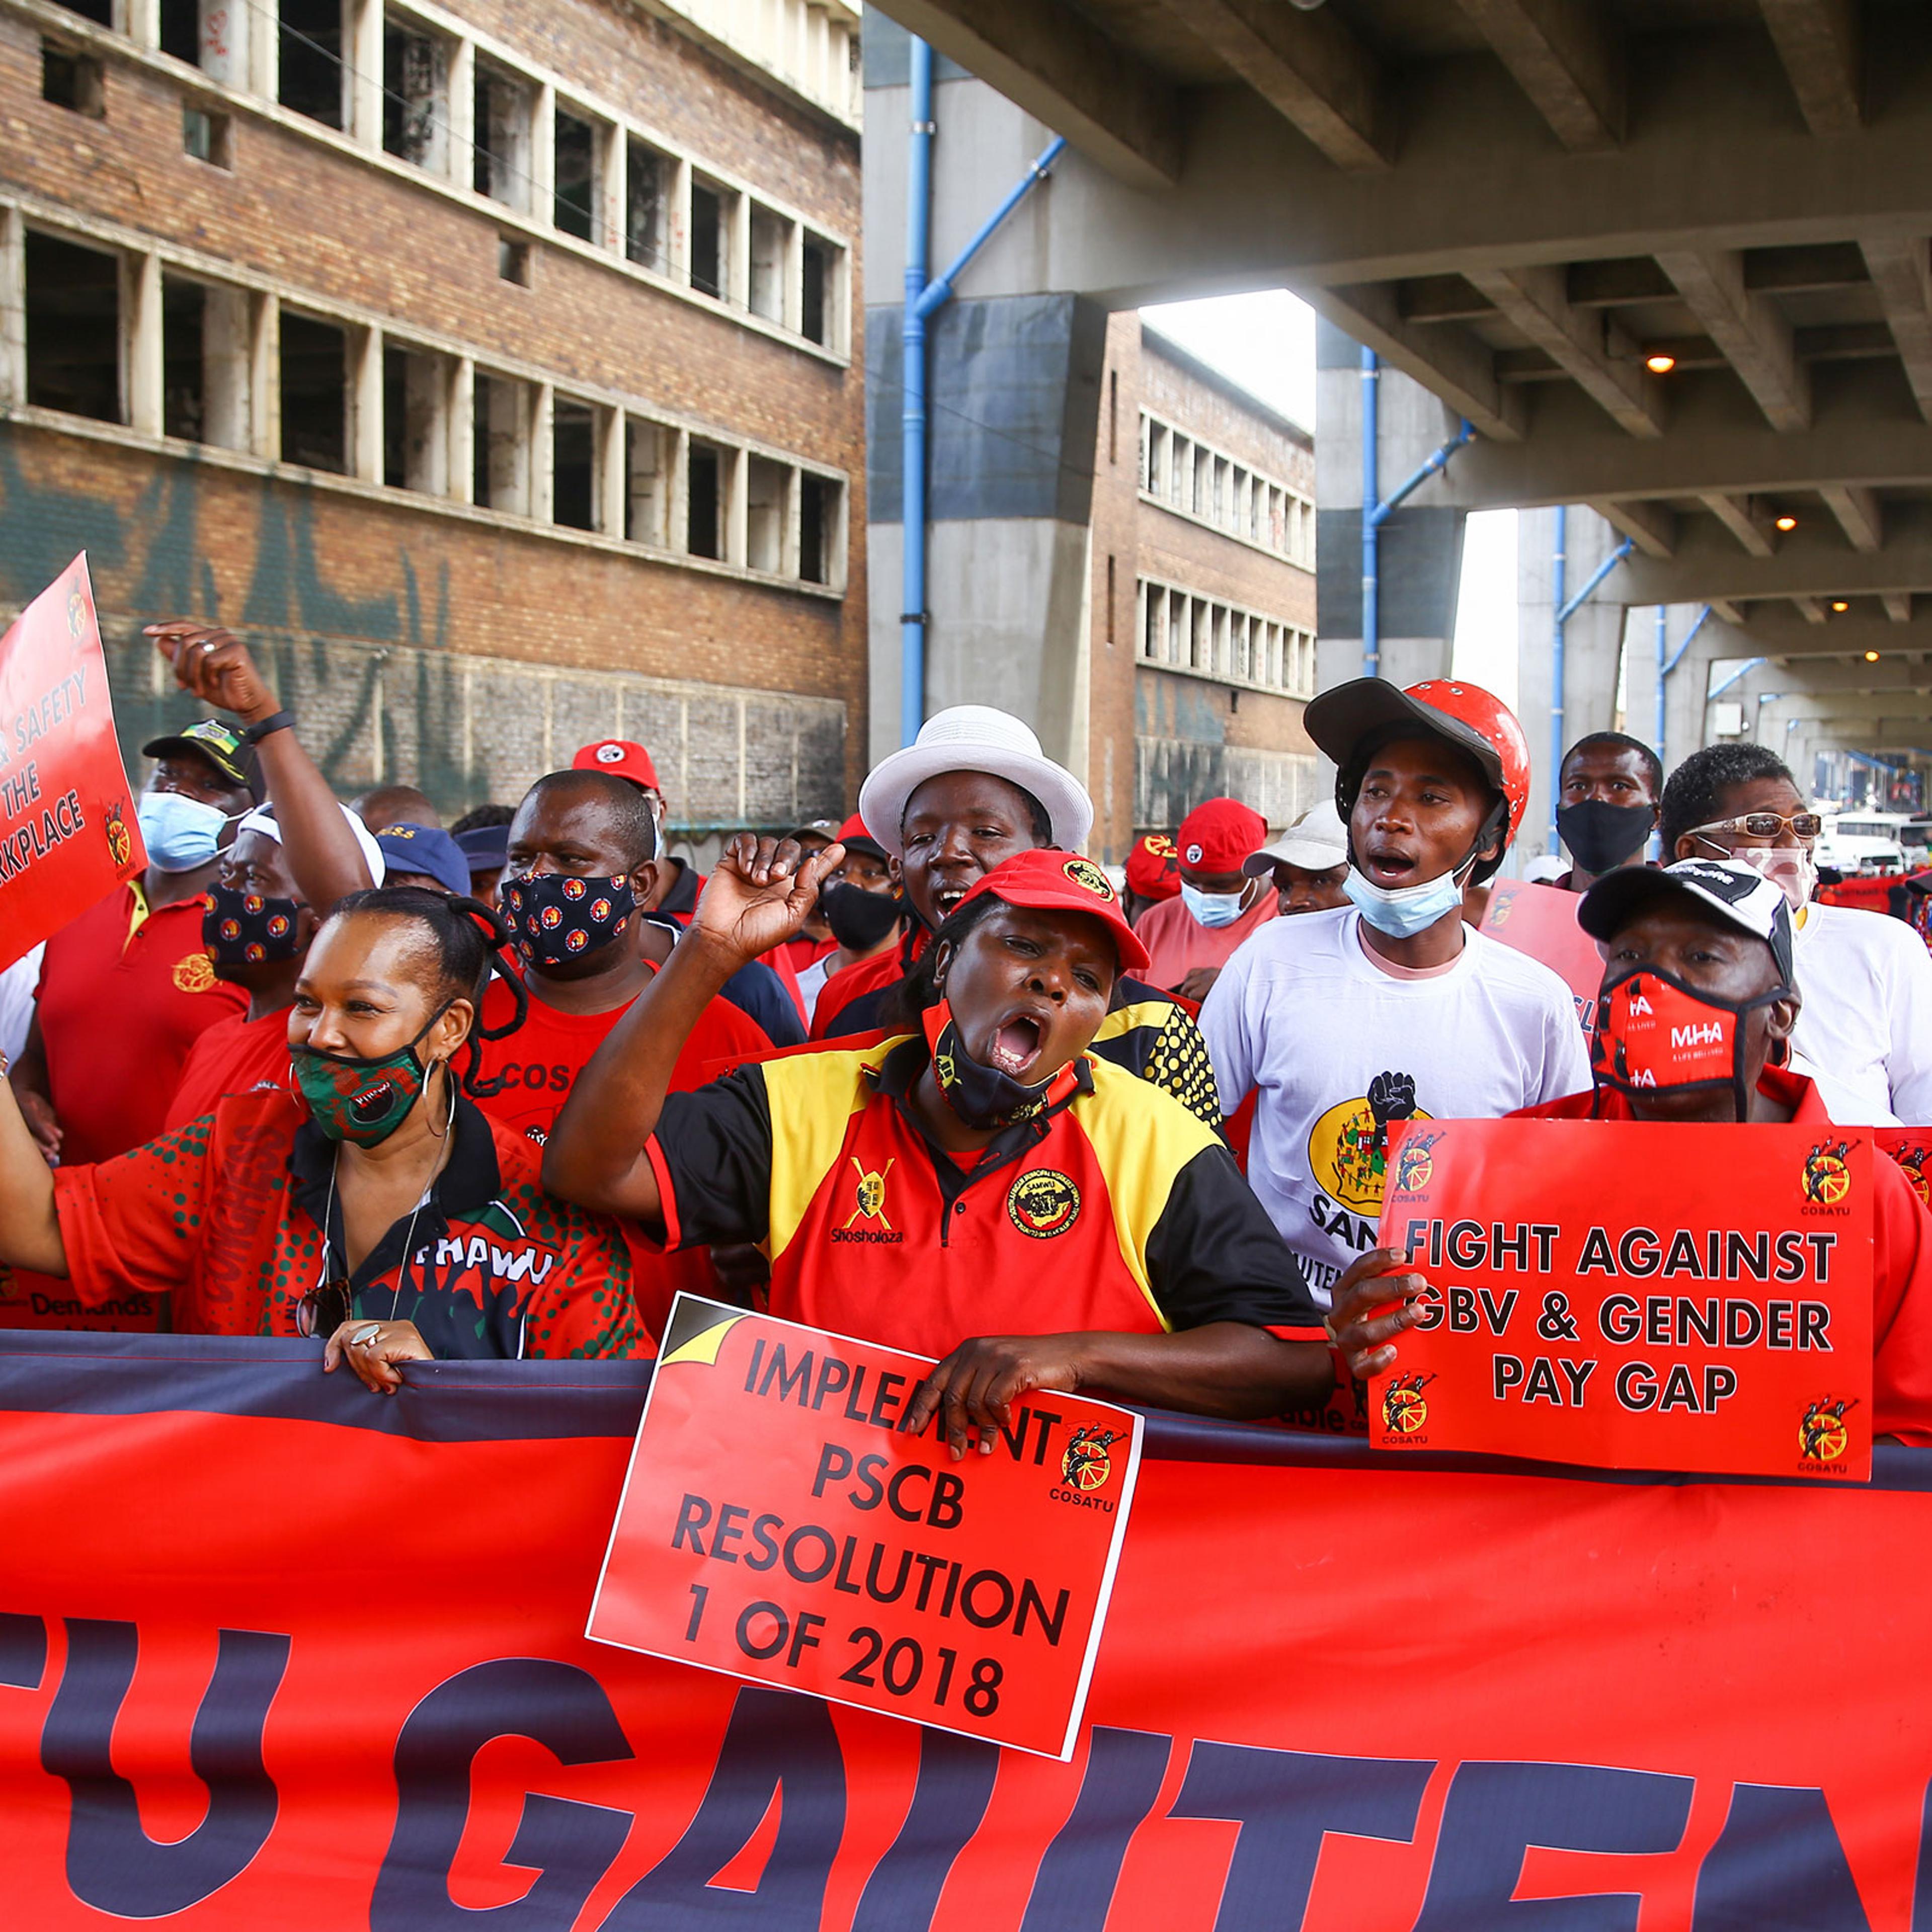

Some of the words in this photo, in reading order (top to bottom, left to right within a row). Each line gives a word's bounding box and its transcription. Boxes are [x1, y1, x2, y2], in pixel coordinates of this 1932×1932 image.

[14, 664, 87, 754] SAFETY
[1, 761, 41, 820] THE
[1670, 1021, 1723, 1049] MHA
[500, 1062, 570, 1092] COS
[831, 1228, 904, 1244] Shosholoza
[1308, 1194, 1379, 1252] SAN
[1800, 1206, 1850, 1217] COSATU
[1404, 1219, 1560, 1273] FIGHT
[1575, 1226, 1837, 1283] AGAINST
[1404, 1284, 1519, 1336] GBV
[1536, 1291, 1581, 1342] &
[1598, 1293, 1833, 1352] GENDER
[744, 1338, 1063, 1466] IMPLENT
[1493, 1353, 1599, 1407] PAY
[1615, 1361, 1738, 1414] GAP
[1382, 1435, 1428, 1444] COSATU
[1797, 1462, 1848, 1474] COSATU
[811, 1442, 964, 1530] PSCB
[1049, 1487, 1114, 1513] COSATU
[671, 1493, 1071, 1647] RESOLUTION
[685, 1583, 709, 1642] 1
[735, 1600, 827, 1668] OF
[838, 1627, 1004, 1718] 2018
